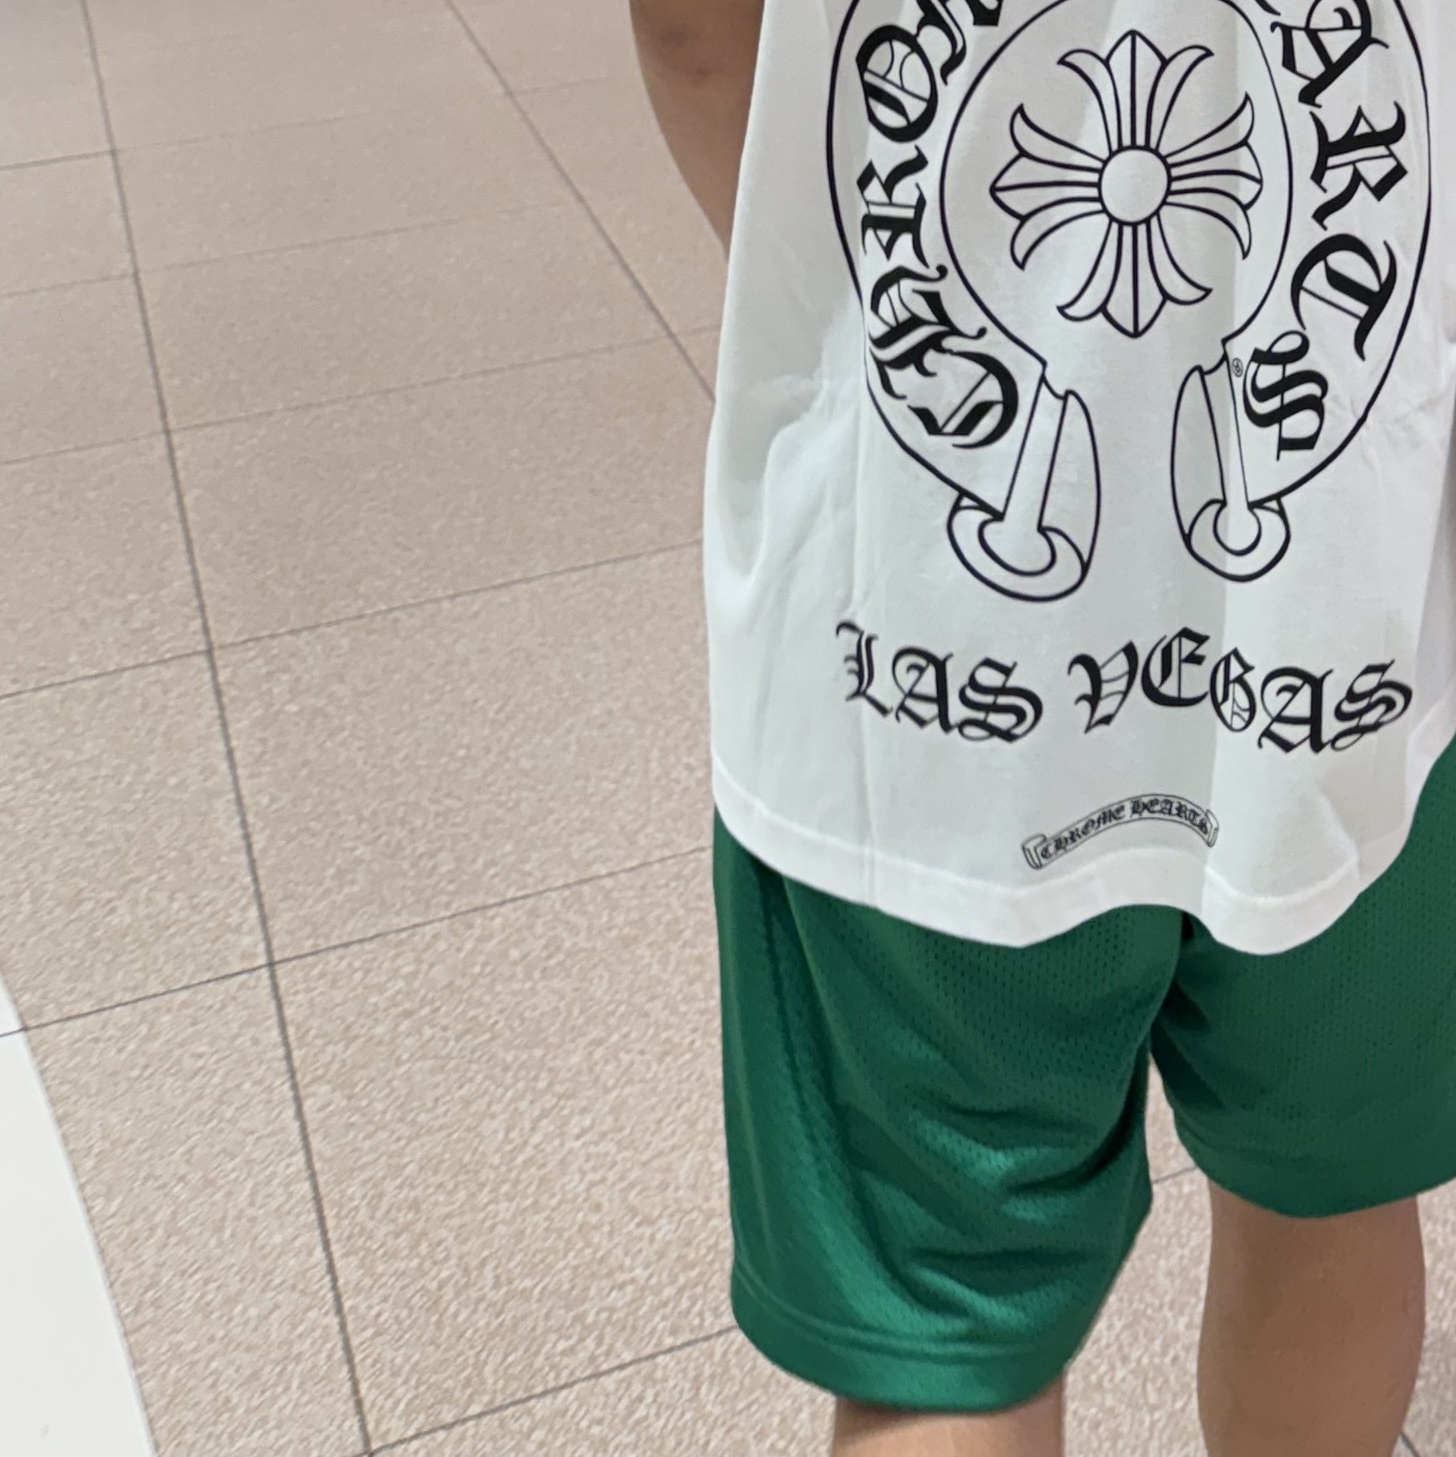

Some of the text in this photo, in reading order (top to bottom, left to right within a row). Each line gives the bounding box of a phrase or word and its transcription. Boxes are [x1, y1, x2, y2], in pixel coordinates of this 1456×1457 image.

[835, 620, 1413, 754] LAS VEGAS
[1040, 804, 1126, 860] CHROME
